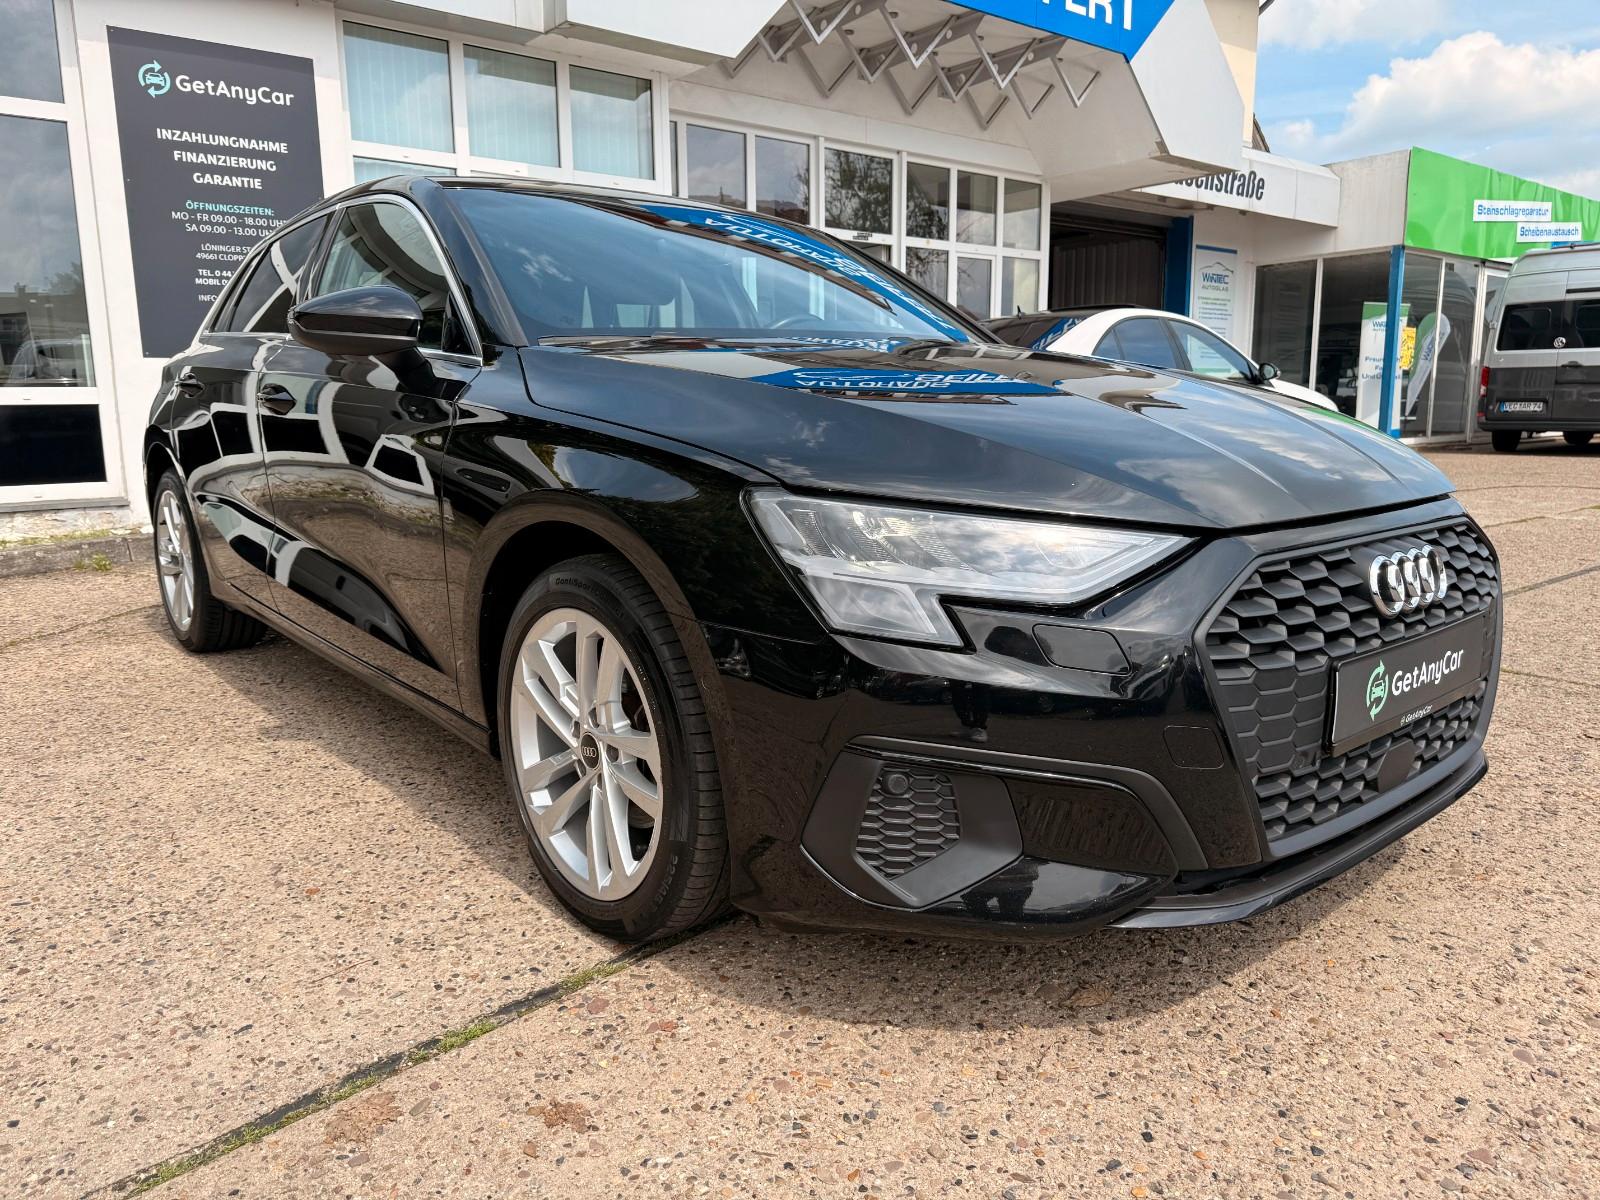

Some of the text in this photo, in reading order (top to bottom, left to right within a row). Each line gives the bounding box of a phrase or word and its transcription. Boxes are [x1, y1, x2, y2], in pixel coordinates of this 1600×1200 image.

[175, 74, 294, 106] GetAnyCar
[156, 127, 288, 154] INZAHLUNGNAHME
[173, 150, 276, 171] FINANZIERUNG
[193, 172, 262, 189] GARANTIE
[185, 200, 275, 216] ÖFFNUNGSZEITEN:
[171, 211, 189, 220] MO
[197, 213, 209, 222] FR
[210, 214, 237, 224] 09.00
[244, 217, 268, 226] 18.00
[185, 223, 198, 232] SA
[200, 224, 226, 234] 09.00
[233, 227, 257, 236] 13.00
[201, 243, 252, 254] LÖNINGER ST
[1391, 649, 1464, 697] GetAnyCar
